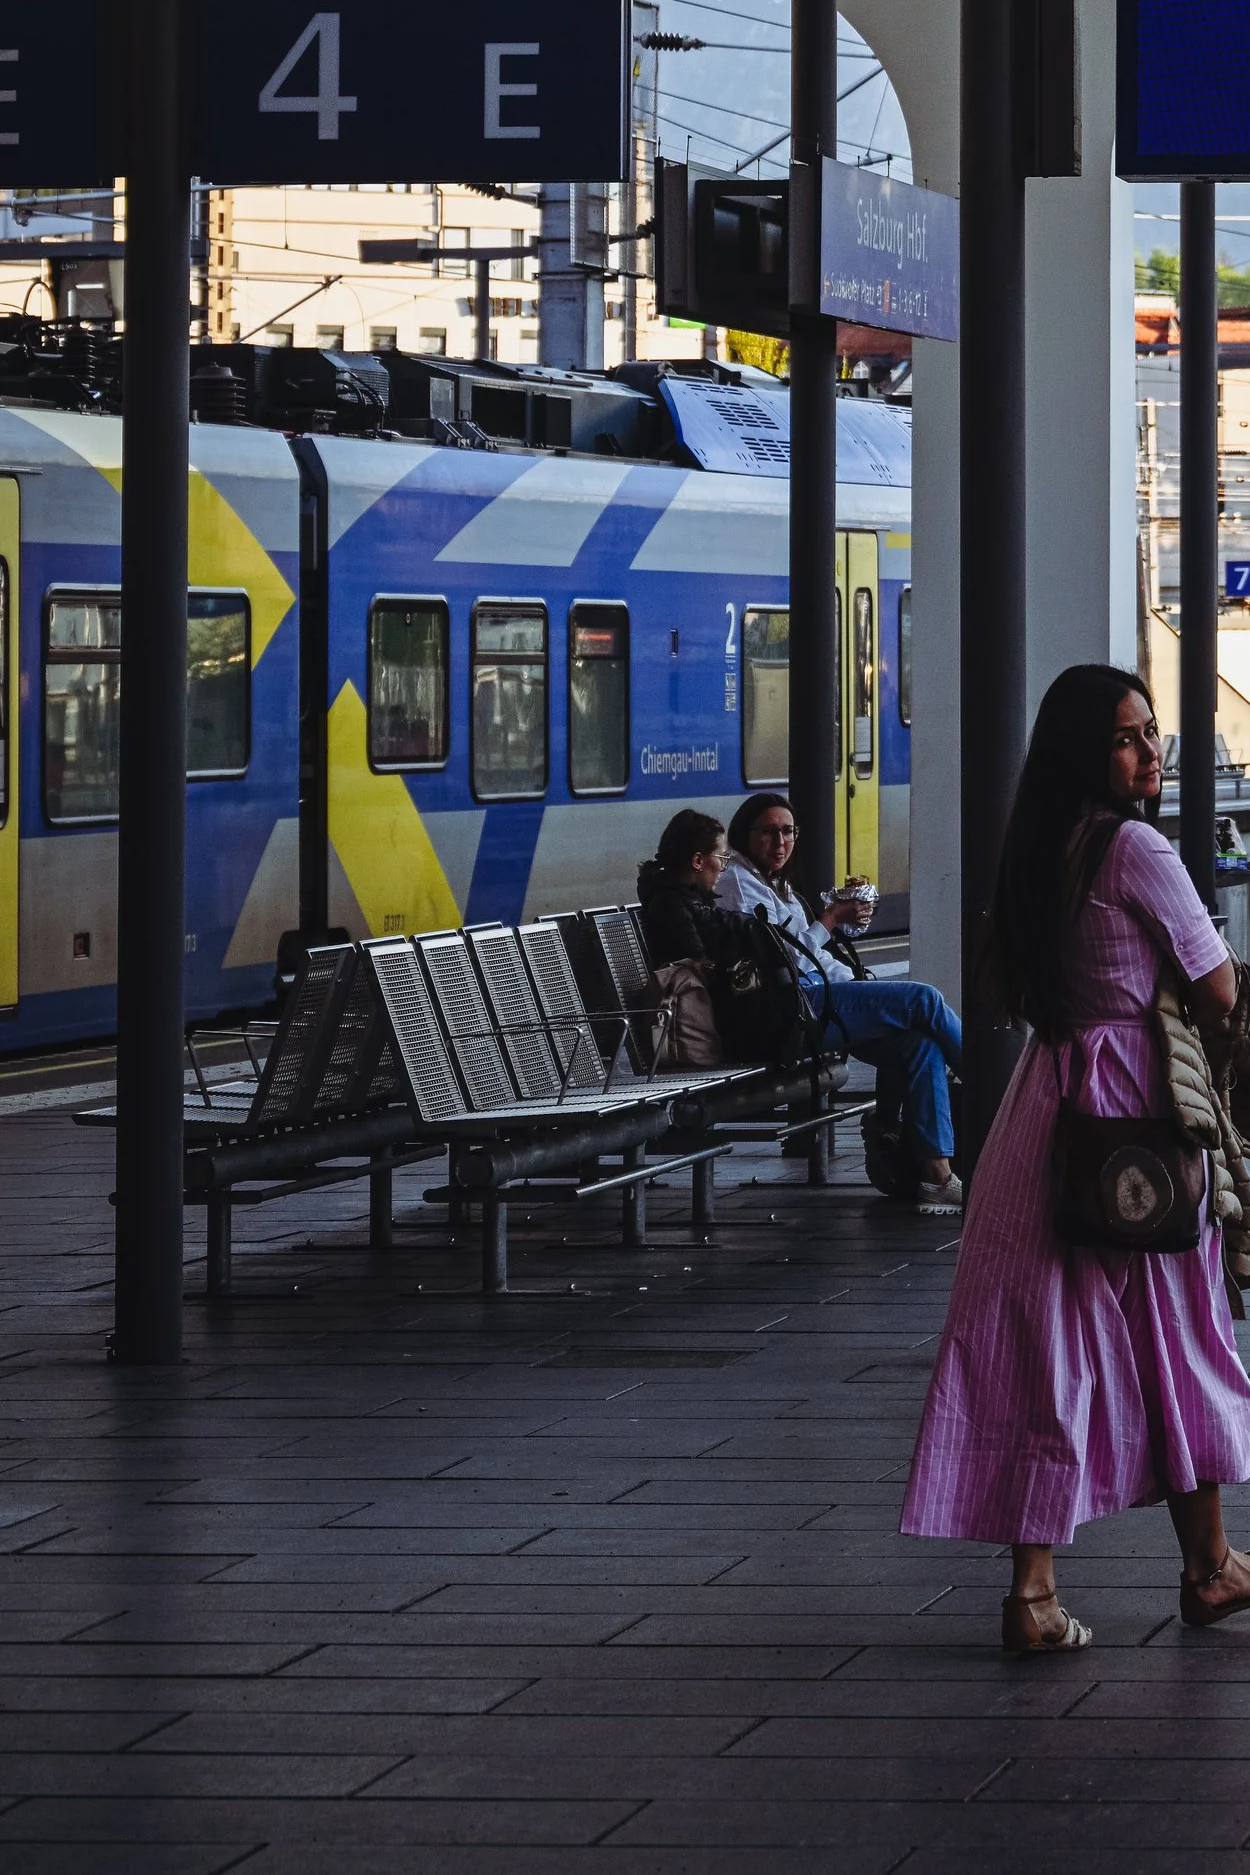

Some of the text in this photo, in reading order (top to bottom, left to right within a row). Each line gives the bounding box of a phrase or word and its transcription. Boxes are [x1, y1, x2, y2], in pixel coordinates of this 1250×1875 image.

[257, 11, 541, 141] 4 E
[856, 198, 928, 270] Salzburg Hbf.
[1234, 567, 1250, 590] 7
[725, 602, 736, 654] 2
